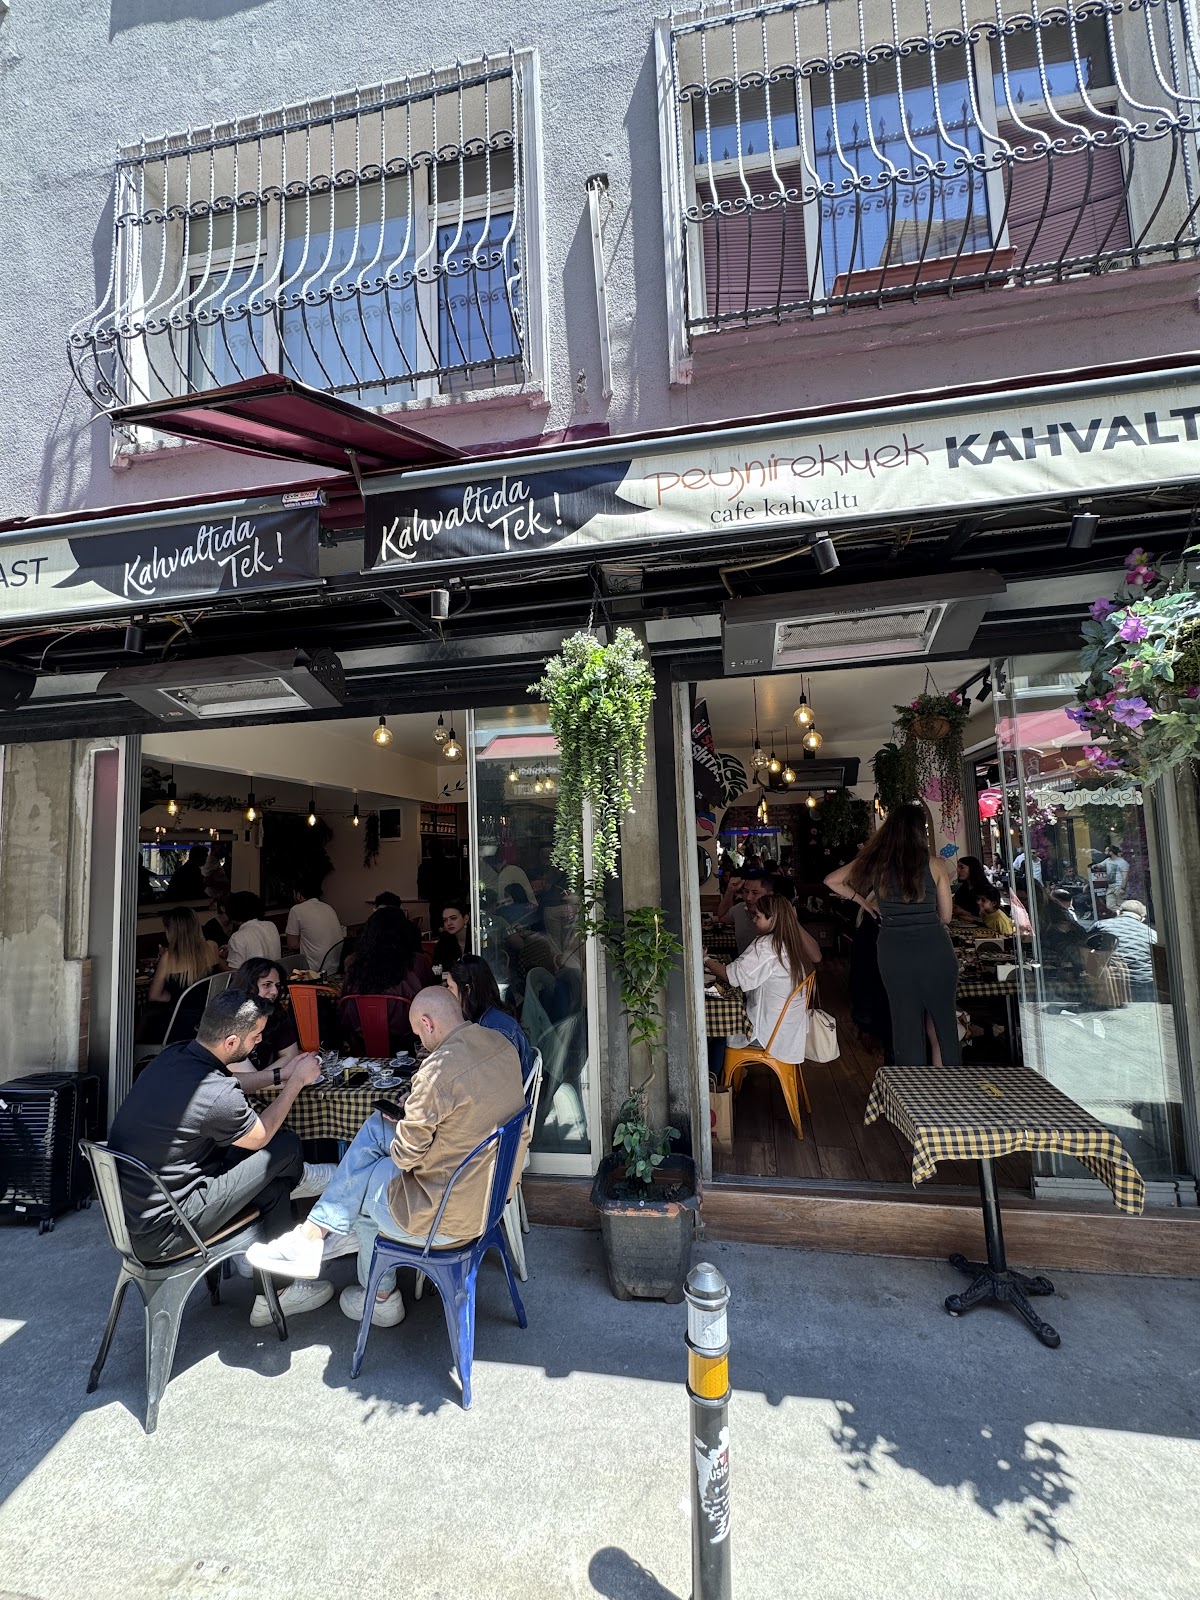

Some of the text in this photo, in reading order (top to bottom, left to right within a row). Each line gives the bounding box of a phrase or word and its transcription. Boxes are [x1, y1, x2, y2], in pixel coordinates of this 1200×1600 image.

[381, 475, 530, 562] Kahvaltıda
[710, 490, 860, 524] cafe kahvaltı
[123, 515, 256, 597] Kahvaltıda
